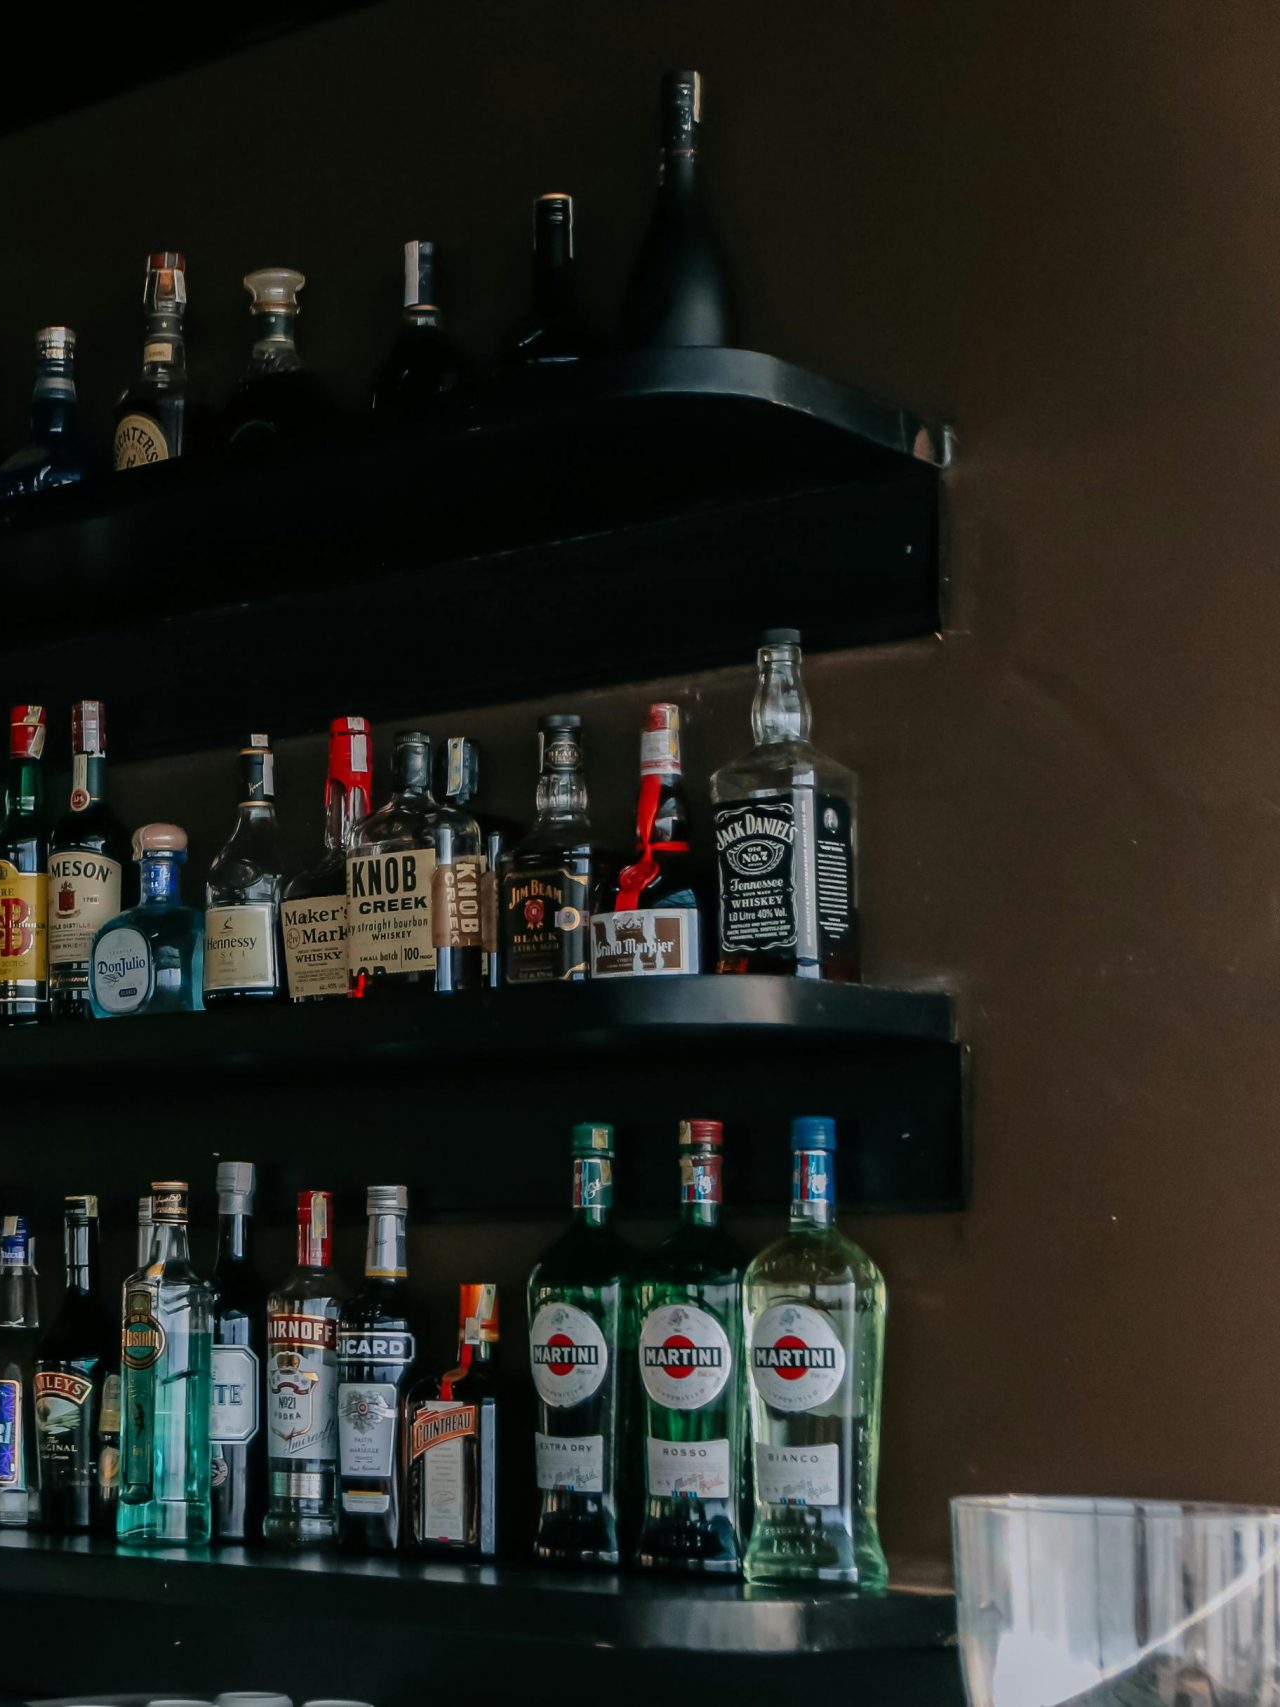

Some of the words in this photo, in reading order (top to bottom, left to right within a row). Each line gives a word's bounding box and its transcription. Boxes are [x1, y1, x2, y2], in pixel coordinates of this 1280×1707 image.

[716, 821, 745, 850] JACK
[745, 814, 798, 843] DANIEL'S
[742, 852, 768, 863] No.7
[352, 856, 417, 898] KNOB
[730, 879, 784, 891] Tennessee
[360, 896, 428, 914] CREEK
[456, 862, 480, 933] KNOB
[731, 895, 783, 909] WHISKEY
[444, 871, 460, 944] CREEK
[285, 907, 348, 926] Maker's
[357, 919, 390, 933] straight
[393, 915, 428, 928] bourbon
[372, 930, 412, 941] WHISKEY
[513, 934, 558, 943] BLACK
[207, 937, 258, 952] Hennessy
[295, 951, 343, 963] WHISKY
[380, 950, 398, 961] batch
[404, 947, 419, 960] 100
[534, 1346, 597, 1364] MARTINI
[645, 1348, 719, 1366] MARTINI
[755, 1349, 834, 1367] MARTINI
[416, 1412, 471, 1449] COINTREAU
[540, 1442, 567, 1452] EXTRA
[570, 1443, 593, 1453] DRY
[663, 1448, 708, 1458] ROSSO
[767, 1453, 821, 1464] BIANCO
